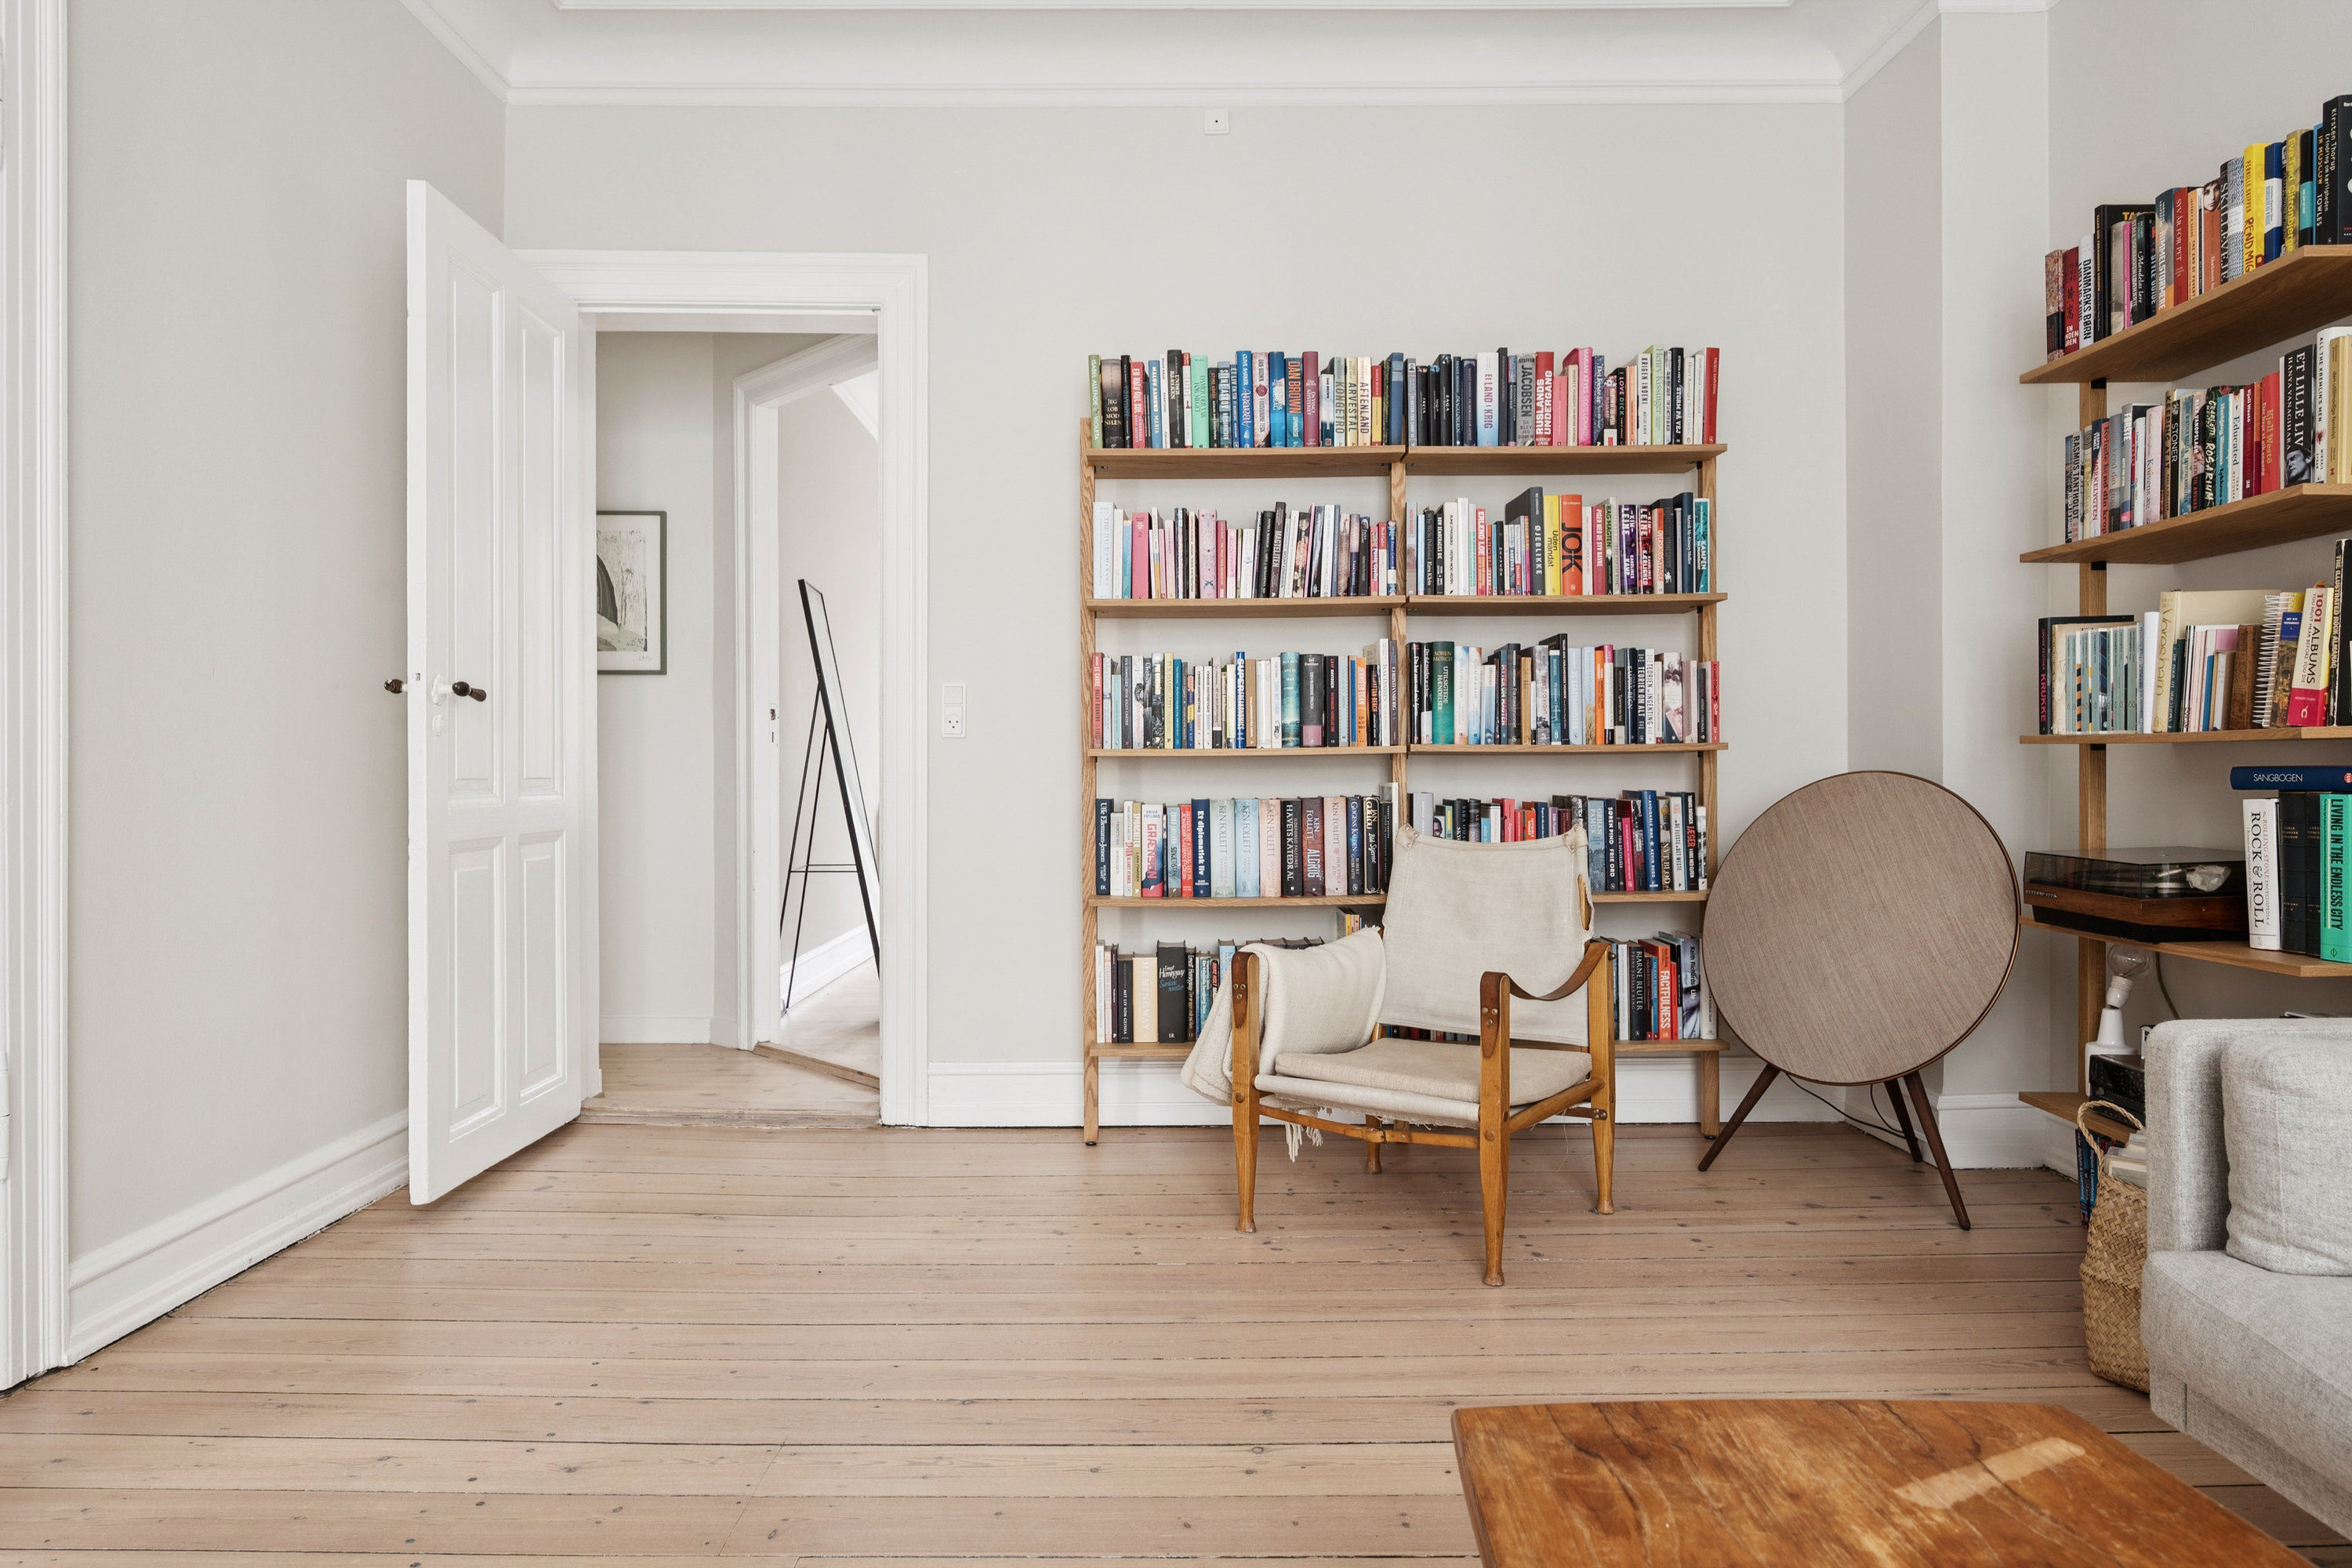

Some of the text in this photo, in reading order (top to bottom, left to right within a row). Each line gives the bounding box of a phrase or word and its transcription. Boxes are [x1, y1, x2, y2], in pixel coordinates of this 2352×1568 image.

[2288, 159, 2296, 180] Tind
[2176, 215, 2183, 226] ÅR
[2220, 182, 2228, 282] SKILLEVEJE
[2244, 217, 2255, 273] REND MIG
[2082, 259, 2092, 340] DANMARKS BØRN
[1289, 361, 1301, 414] DAN BROWN
[1335, 381, 1345, 434] KONGETRO
[1348, 383, 1358, 433] ARVESTÅL
[1359, 383, 1370, 434] AFTENLAND
[1521, 365, 1533, 417] JACOBSEN
[1536, 379, 1544, 434] RUSLANDS
[2293, 352, 2305, 447] ET LILLE LIV
[2232, 416, 2241, 466] Educated
[2263, 409, 2274, 431] Kjell
[2165, 446, 2170, 458] AT
[2165, 459, 2169, 469] IT
[2205, 442, 2216, 502] ROSARIUM
[2072, 436, 2081, 520] RASMUS TANTHOLDT
[2245, 479, 2251, 489] 38
[1622, 508, 1631, 535] LEINE
[2145, 497, 2151, 510] æg
[1273, 530, 1283, 568] MAGTELITEN
[2156, 608, 2173, 696] Vores barn
[2306, 593, 2324, 684] 1001 ALBUMS
[1638, 694, 1646, 705] OM
[2253, 773, 2303, 782] SANGBOGEN
[1198, 811, 1204, 819] Et
[1219, 823, 1228, 854] FOLLETT
[1243, 823, 1251, 854] FOLLETT
[1266, 809, 1275, 856] KEN FOLLETT
[1306, 810, 1315, 840] FOLLETT
[1686, 826, 1696, 847] JÆGER
[1147, 823, 1157, 879] GRÆNSEN
[1196, 820, 1205, 864] diplomatisk
[1307, 848, 1321, 878] ALDRIG
[2330, 798, 2343, 931] LIVING IN THE ENDLESS CITY
[2251, 811, 2264, 928] ROCK & ROLL
[1141, 960, 1149, 1030] HEMINGWAY
[1661, 970, 1671, 1029] FACTFULNESS
